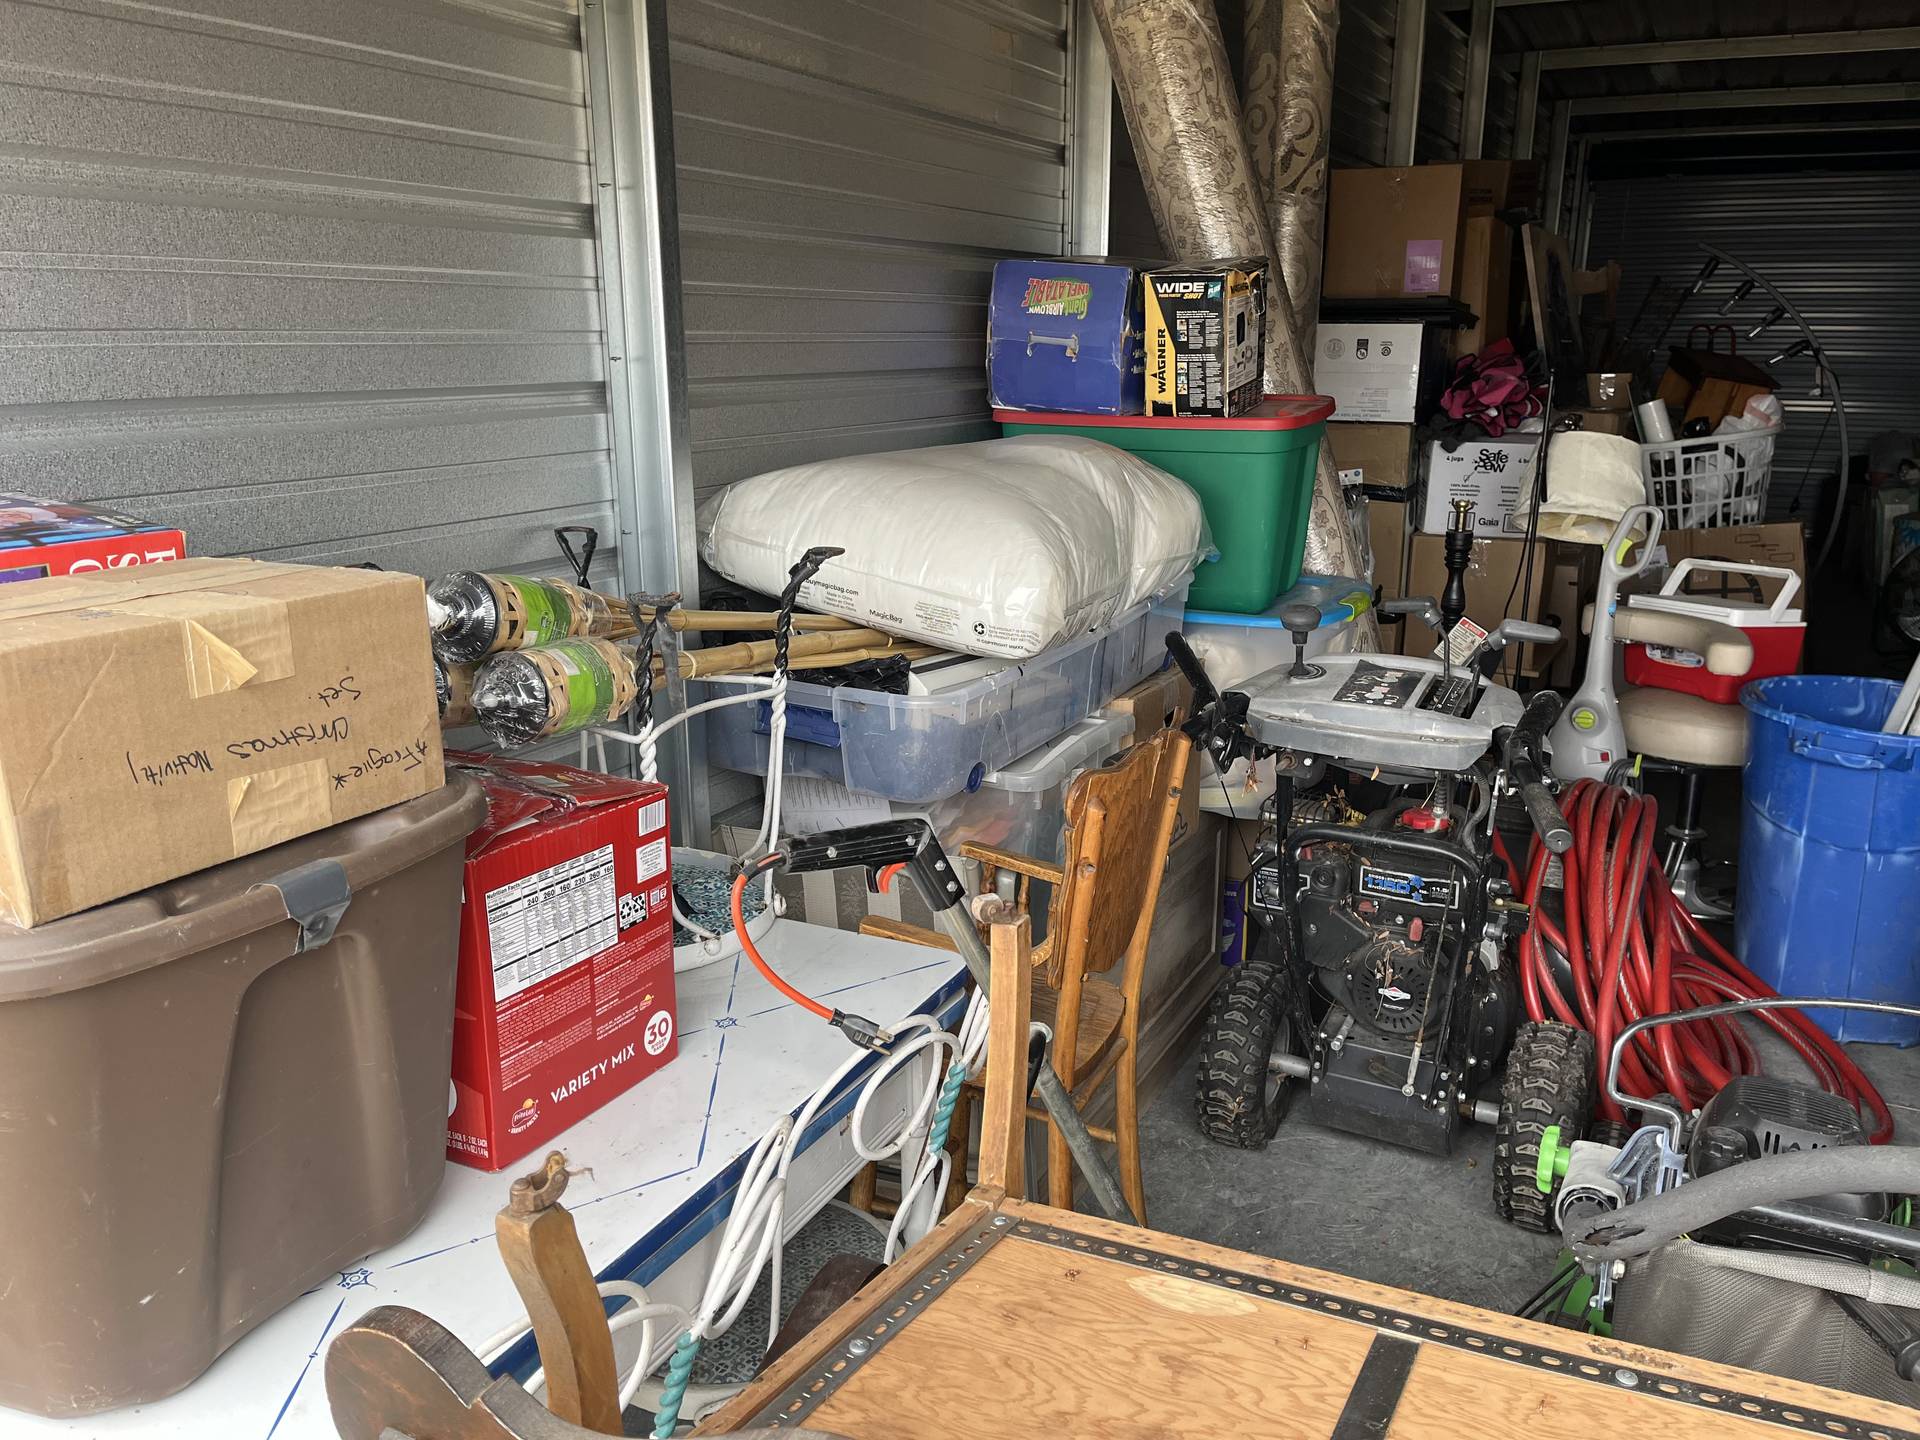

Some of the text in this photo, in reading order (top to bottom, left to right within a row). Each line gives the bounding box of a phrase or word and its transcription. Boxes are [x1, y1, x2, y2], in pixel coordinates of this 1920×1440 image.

[1156, 282, 1205, 293] WIDE
[1157, 328, 1166, 394] WAGNER
[1478, 448, 1509, 464] Safe
[1478, 518, 1499, 526] Gaia
[226, 716, 348, 759] Christmas
[507, 883, 520, 892] Facts
[527, 865, 613, 906] 240 260 160 230 260 160
[647, 1017, 669, 1045] 30
[550, 1043, 636, 1104] VARIETY MIX
